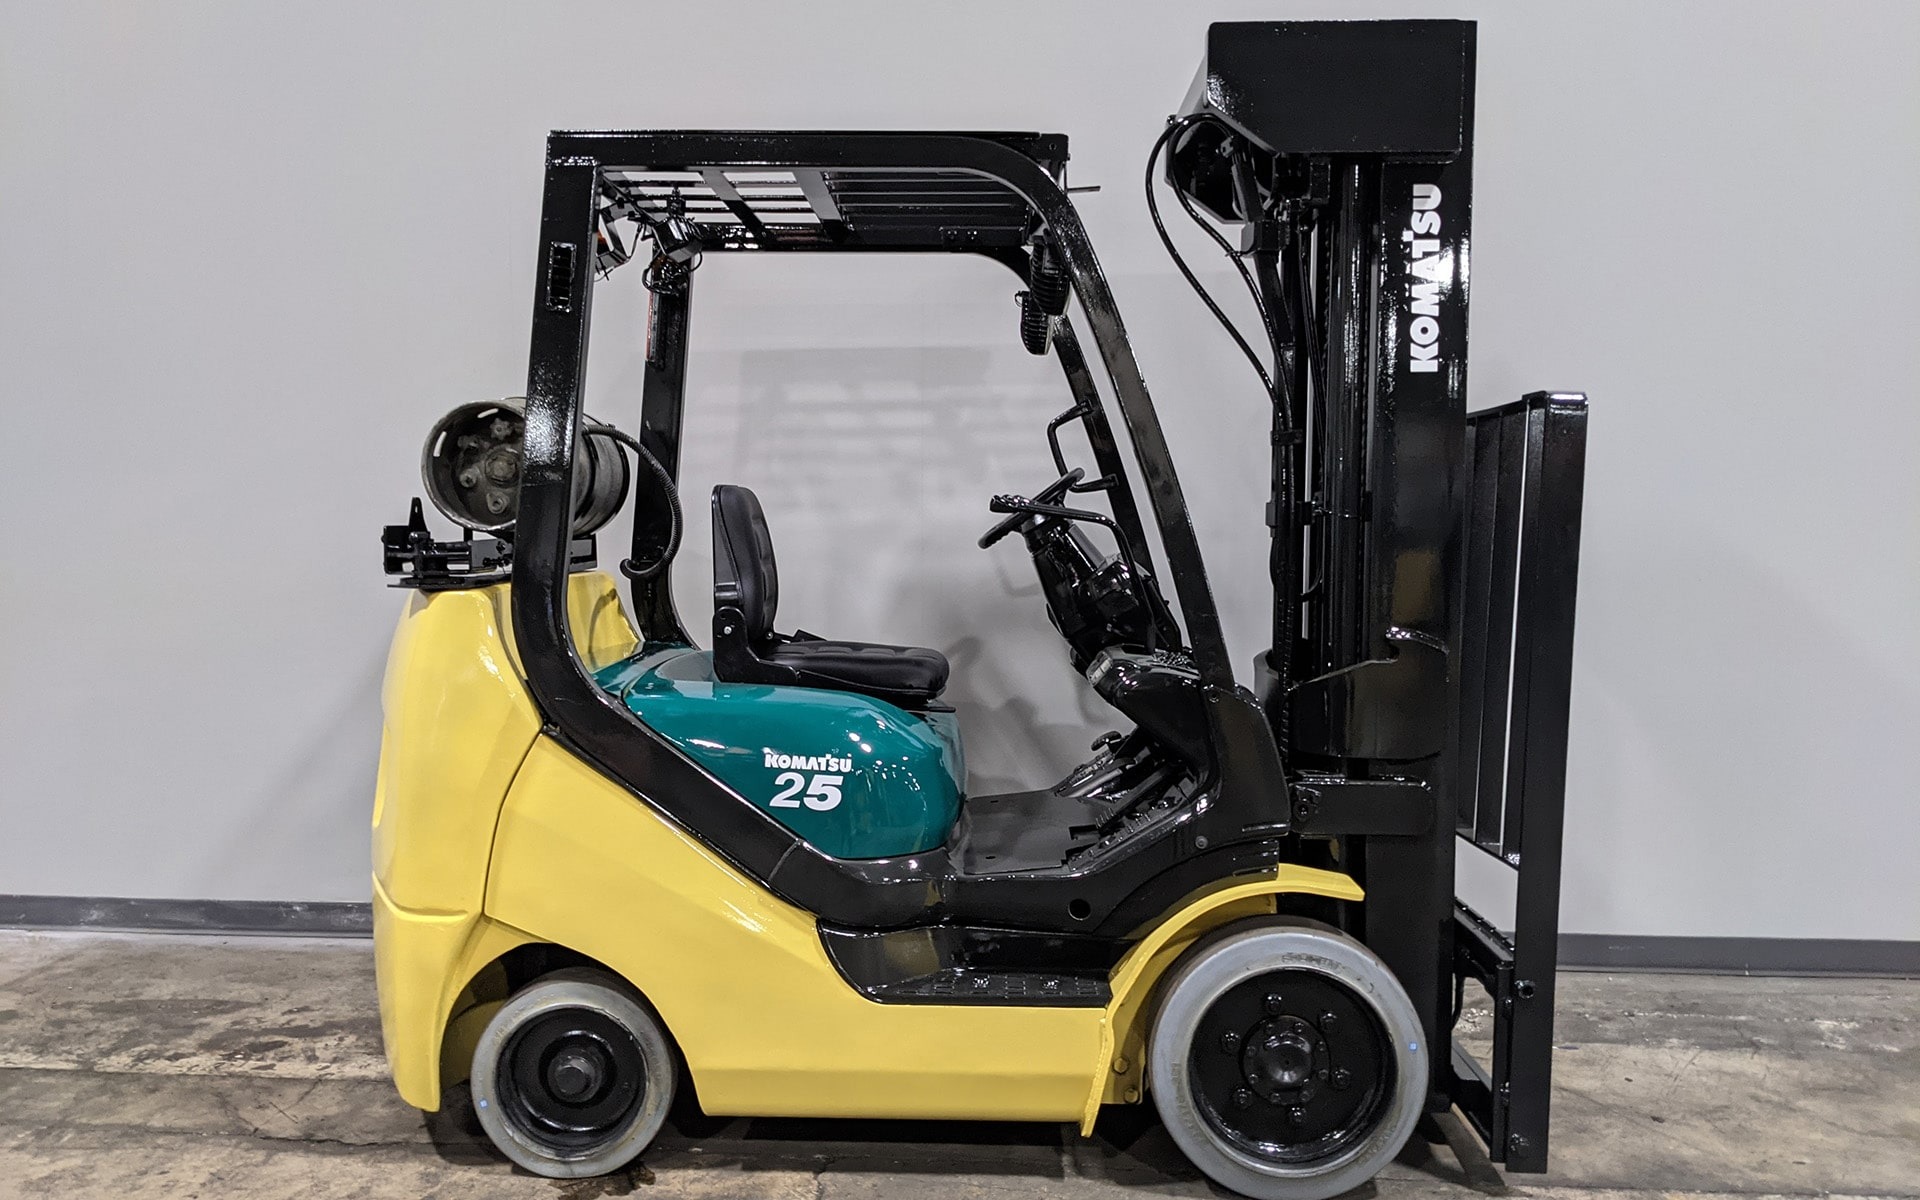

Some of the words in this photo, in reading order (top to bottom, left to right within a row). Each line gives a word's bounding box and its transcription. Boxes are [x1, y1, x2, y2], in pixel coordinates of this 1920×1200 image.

[1402, 183, 1442, 373] KOMATSU
[764, 754, 852, 772] KOMATSU
[769, 772, 844, 811] 25
